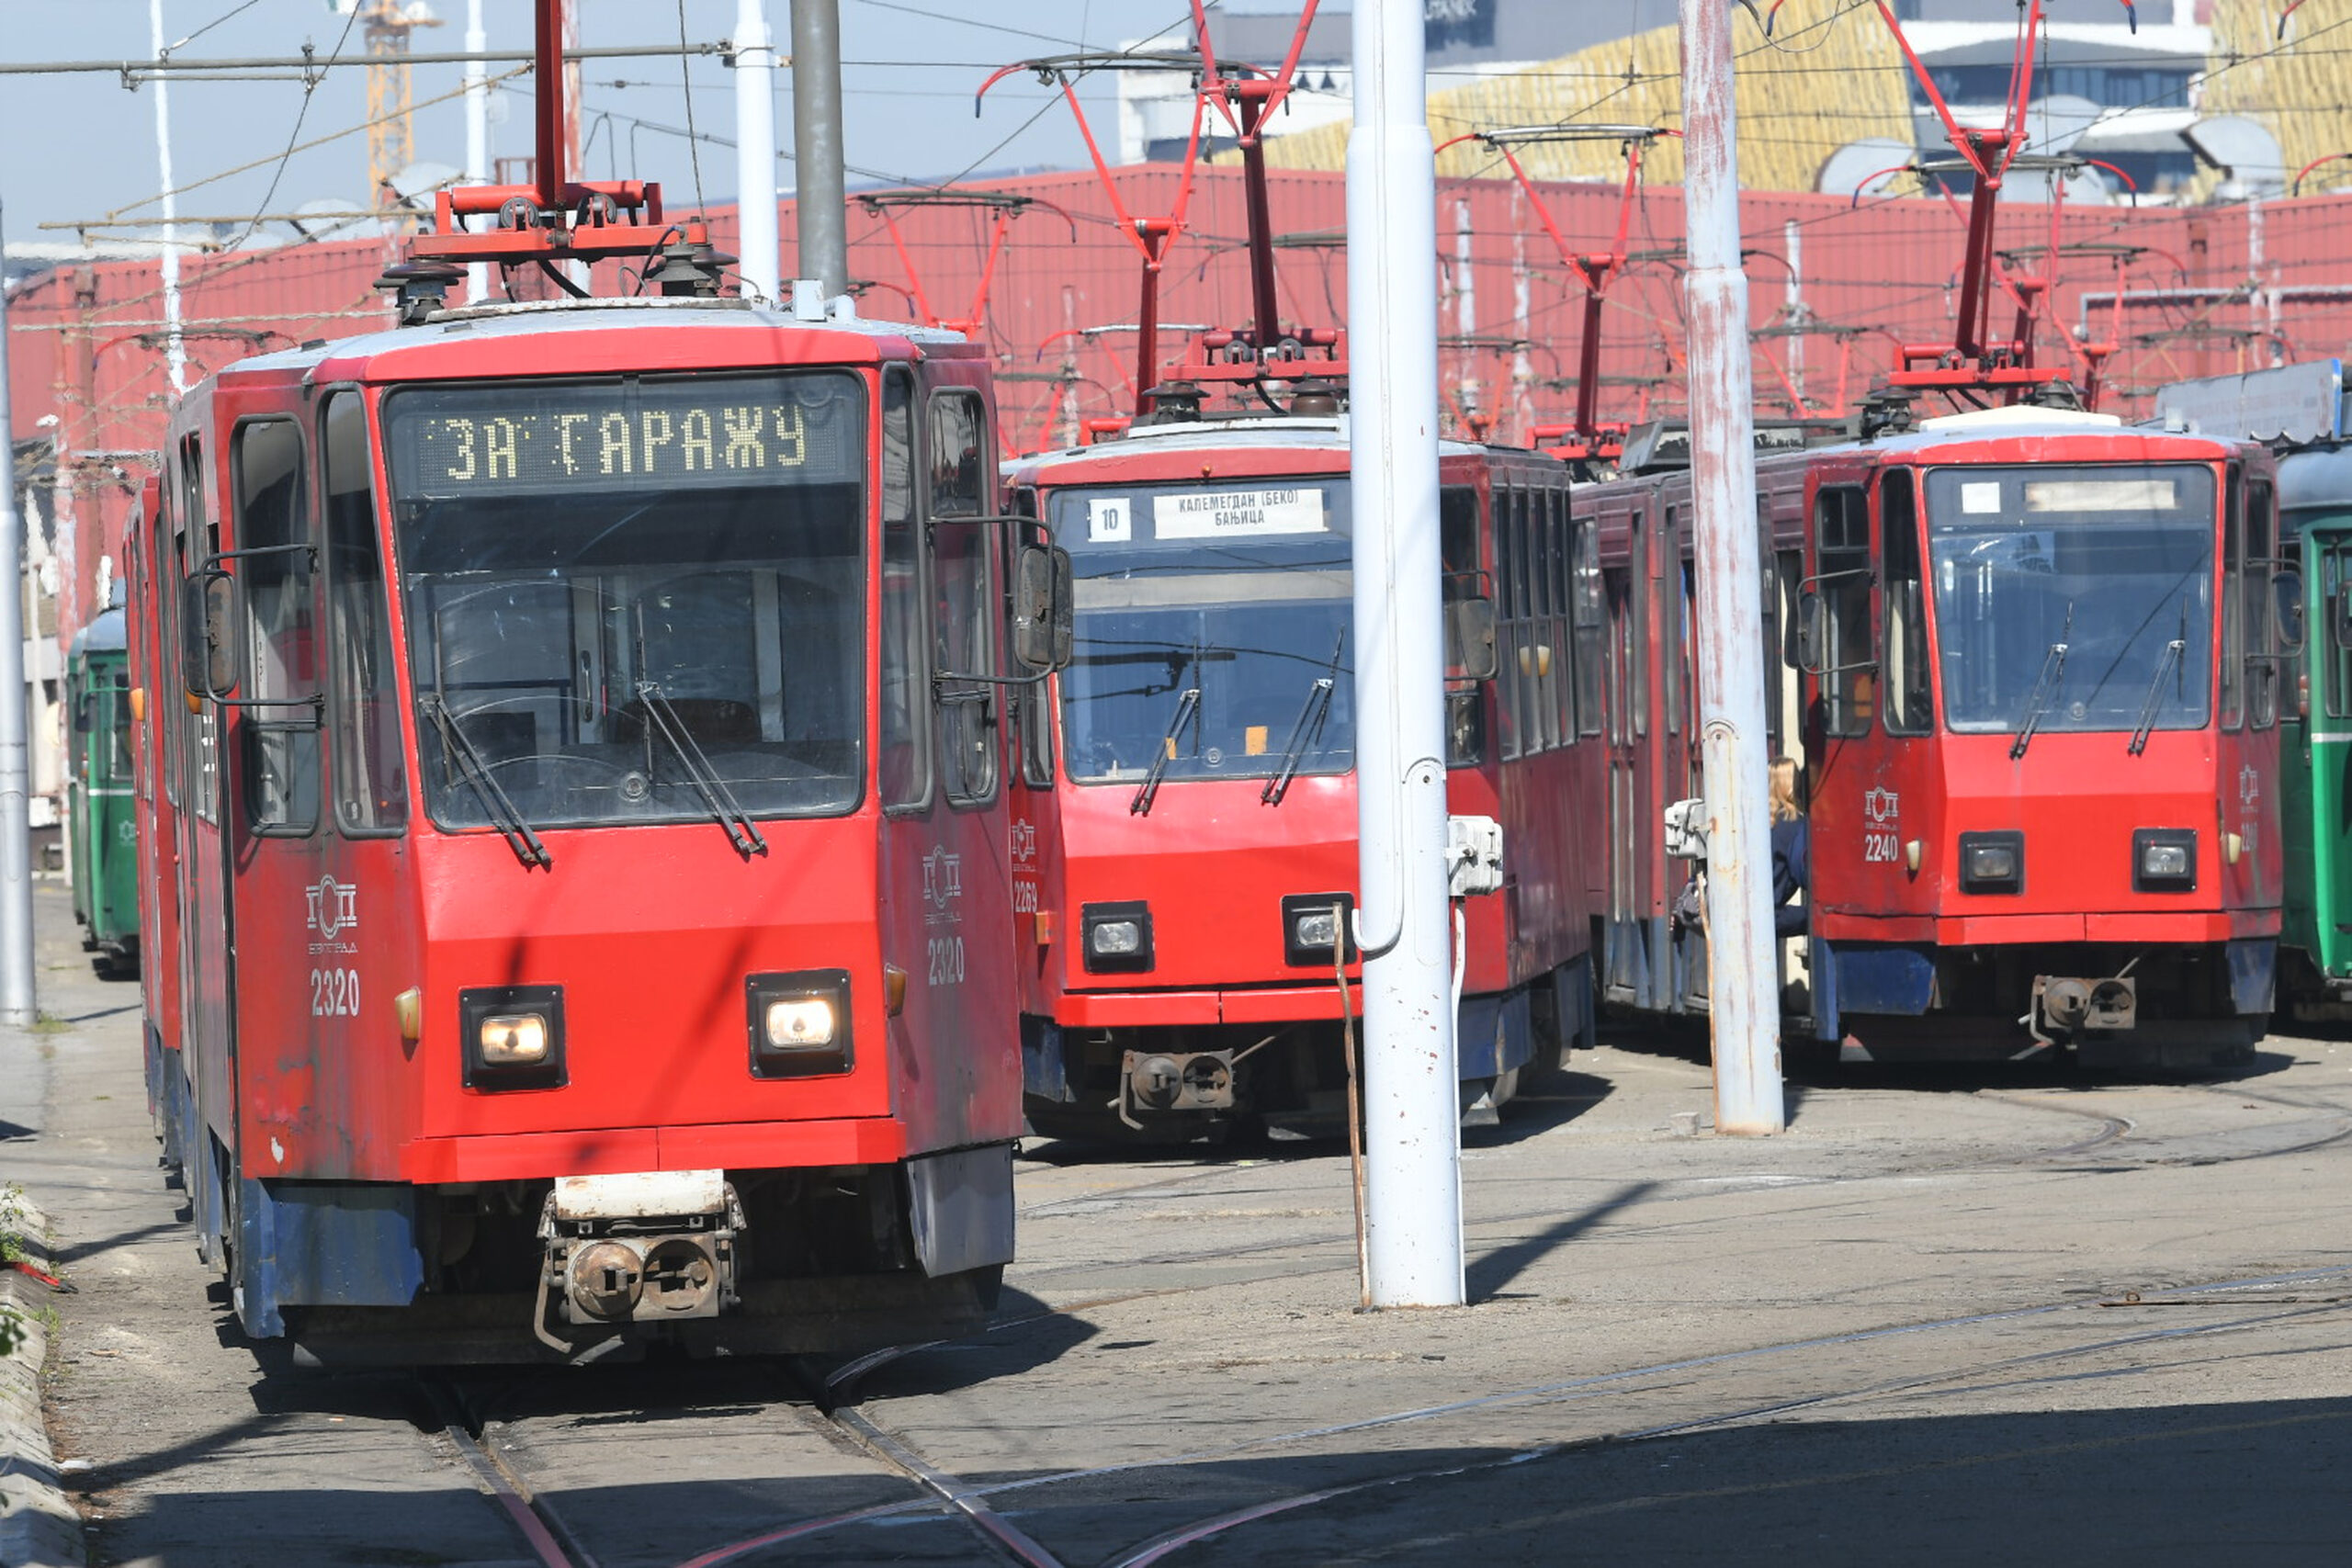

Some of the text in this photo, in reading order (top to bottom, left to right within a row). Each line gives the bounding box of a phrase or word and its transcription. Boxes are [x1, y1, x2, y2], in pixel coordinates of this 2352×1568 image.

[447, 405, 806, 479] ЗА ГАРАЖУ
[1179, 490, 1299, 513] КАЛЕМЕГДАН (БЕКО)
[1102, 508, 1119, 530] 10
[1215, 509, 1265, 526] БАЊИЦА
[1865, 834, 1898, 862] 2240
[1014, 881, 1037, 913] 2269
[928, 936, 964, 986] 2320
[311, 967, 359, 1017] 2320
